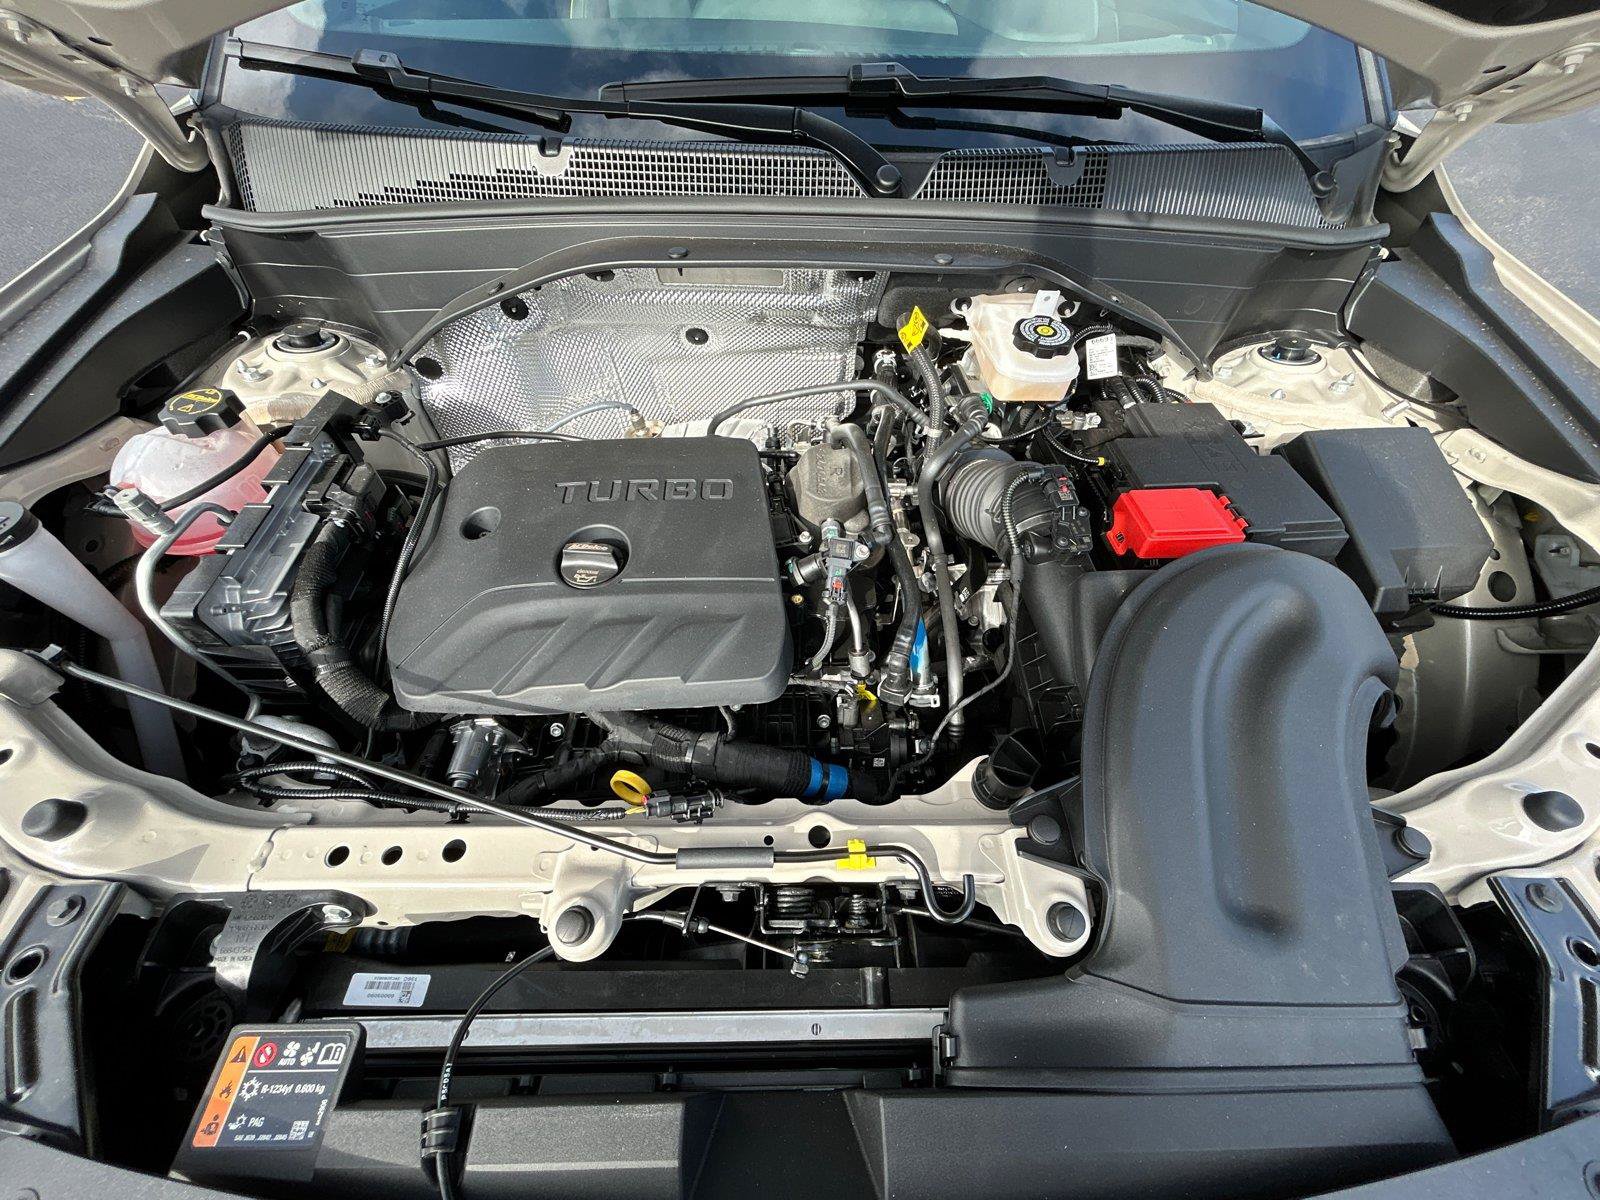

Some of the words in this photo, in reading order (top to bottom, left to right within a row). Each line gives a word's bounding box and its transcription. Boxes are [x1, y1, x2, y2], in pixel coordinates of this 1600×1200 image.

[554, 478, 734, 504] TURBO
[278, 1058, 296, 1066] AUTO
[314, 1083, 326, 1095] kg
[247, 1117, 265, 1128] PAG
